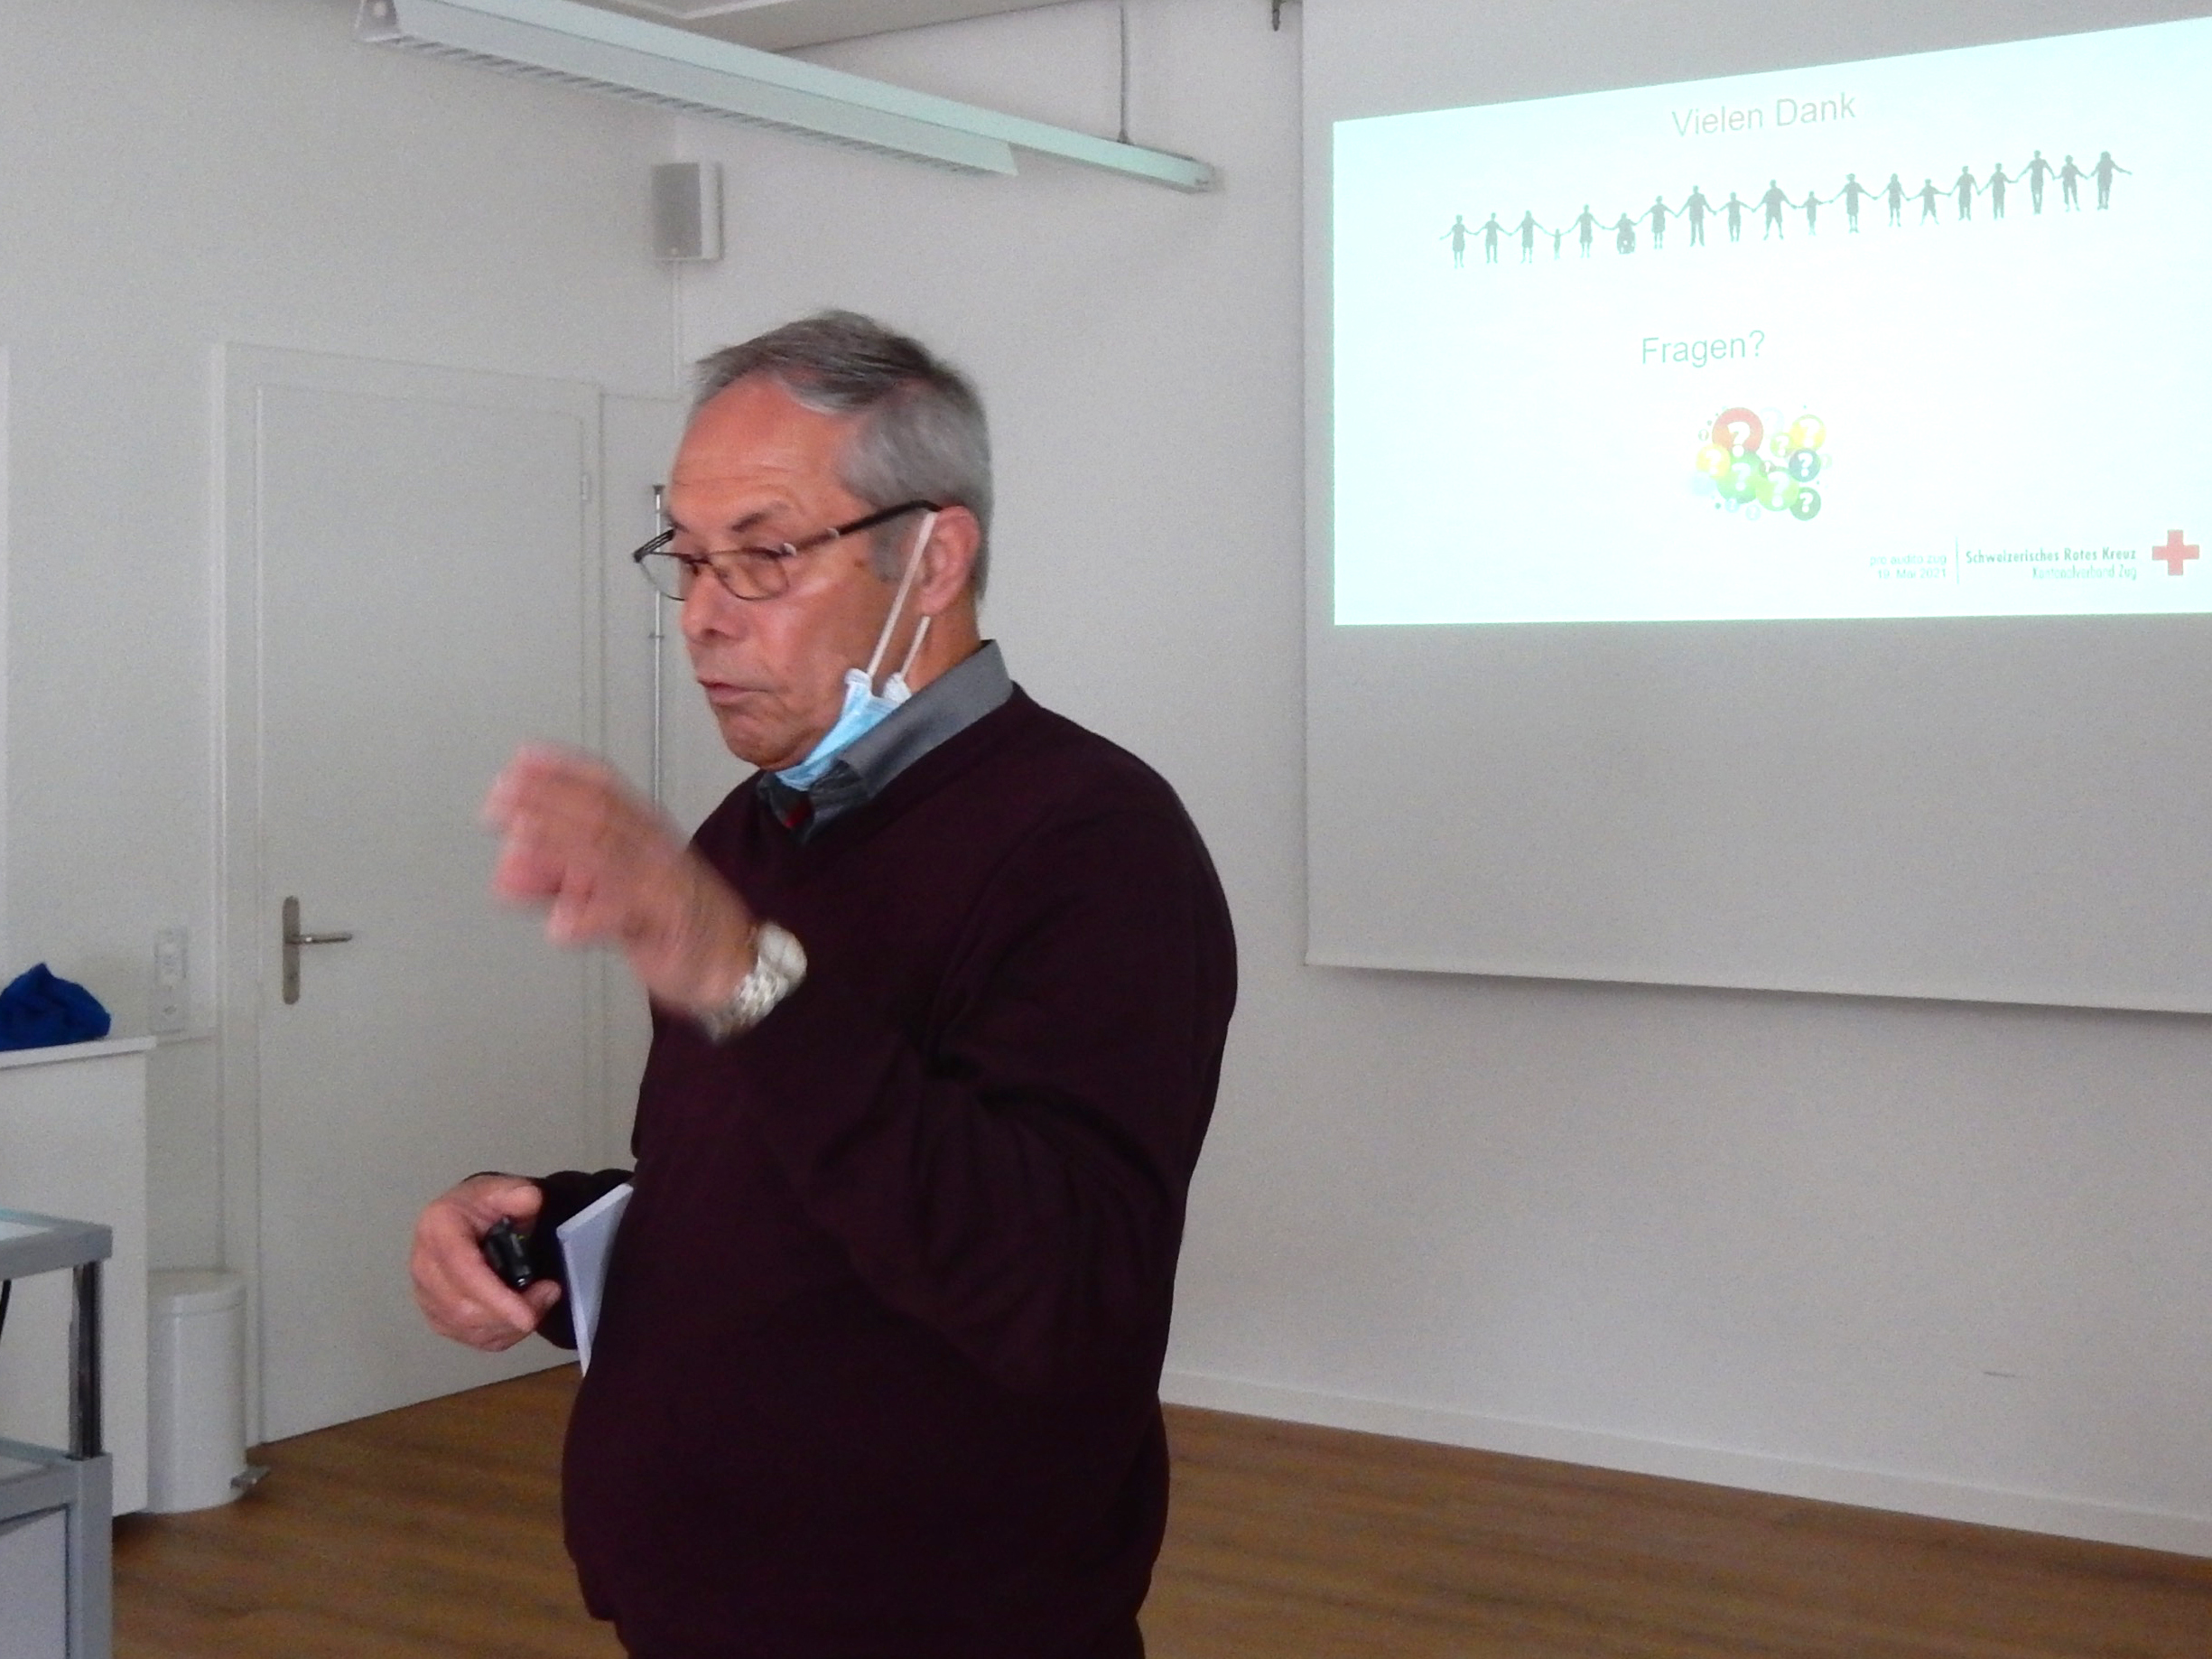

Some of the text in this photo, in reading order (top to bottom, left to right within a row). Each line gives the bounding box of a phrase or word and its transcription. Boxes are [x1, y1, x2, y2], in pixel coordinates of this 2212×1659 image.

[1671, 92, 1856, 136] Vielen Dank
[1641, 330, 1765, 368] Fragen?
[1966, 545, 2137, 564] Schweizerisches Rotes Kreuz
[1919, 567, 1947, 579] 2021
[2118, 564, 2138, 582] Zug
